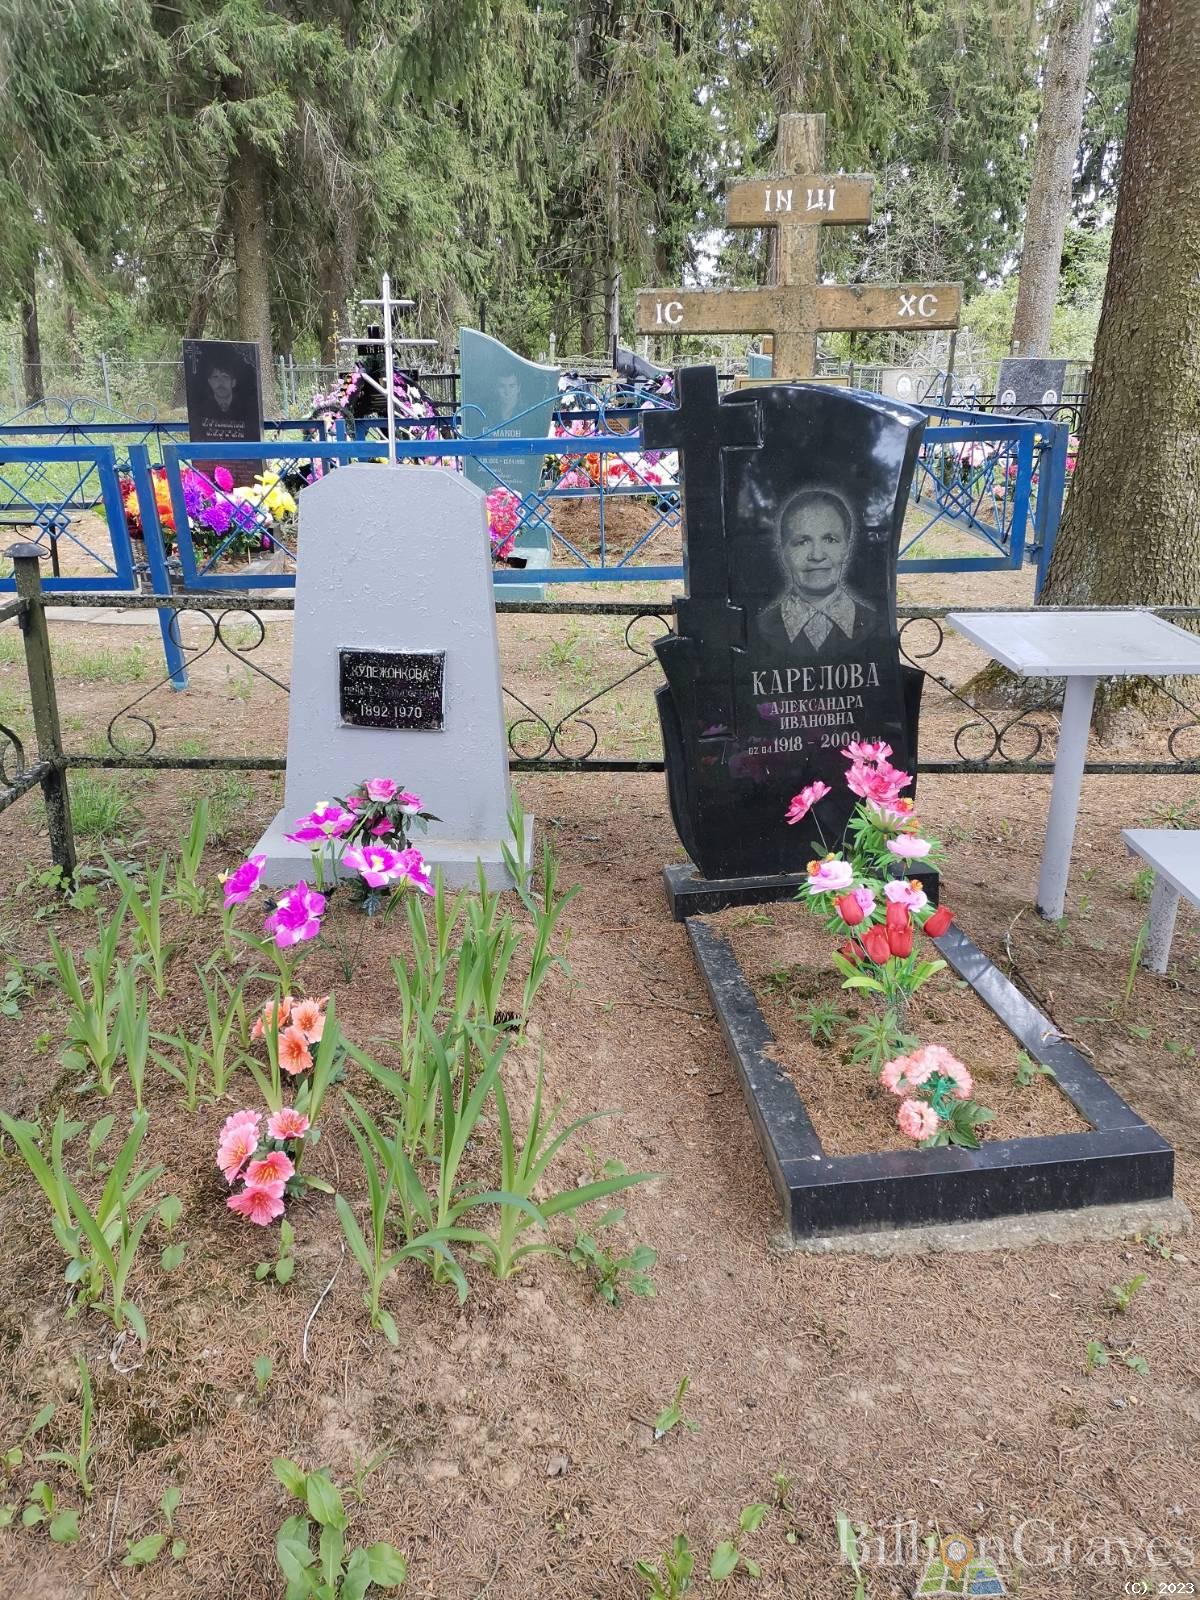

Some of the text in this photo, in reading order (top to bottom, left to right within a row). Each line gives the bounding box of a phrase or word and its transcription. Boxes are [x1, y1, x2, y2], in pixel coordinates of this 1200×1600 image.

[751, 662, 880, 696] КАРЕЛОВА
[769, 695, 864, 715] АЛЕКСАНДРА
[780, 712, 855, 730] ИВАНОВНА
[774, 736, 803, 753] 1918
[820, 731, 860, 748] 2009
